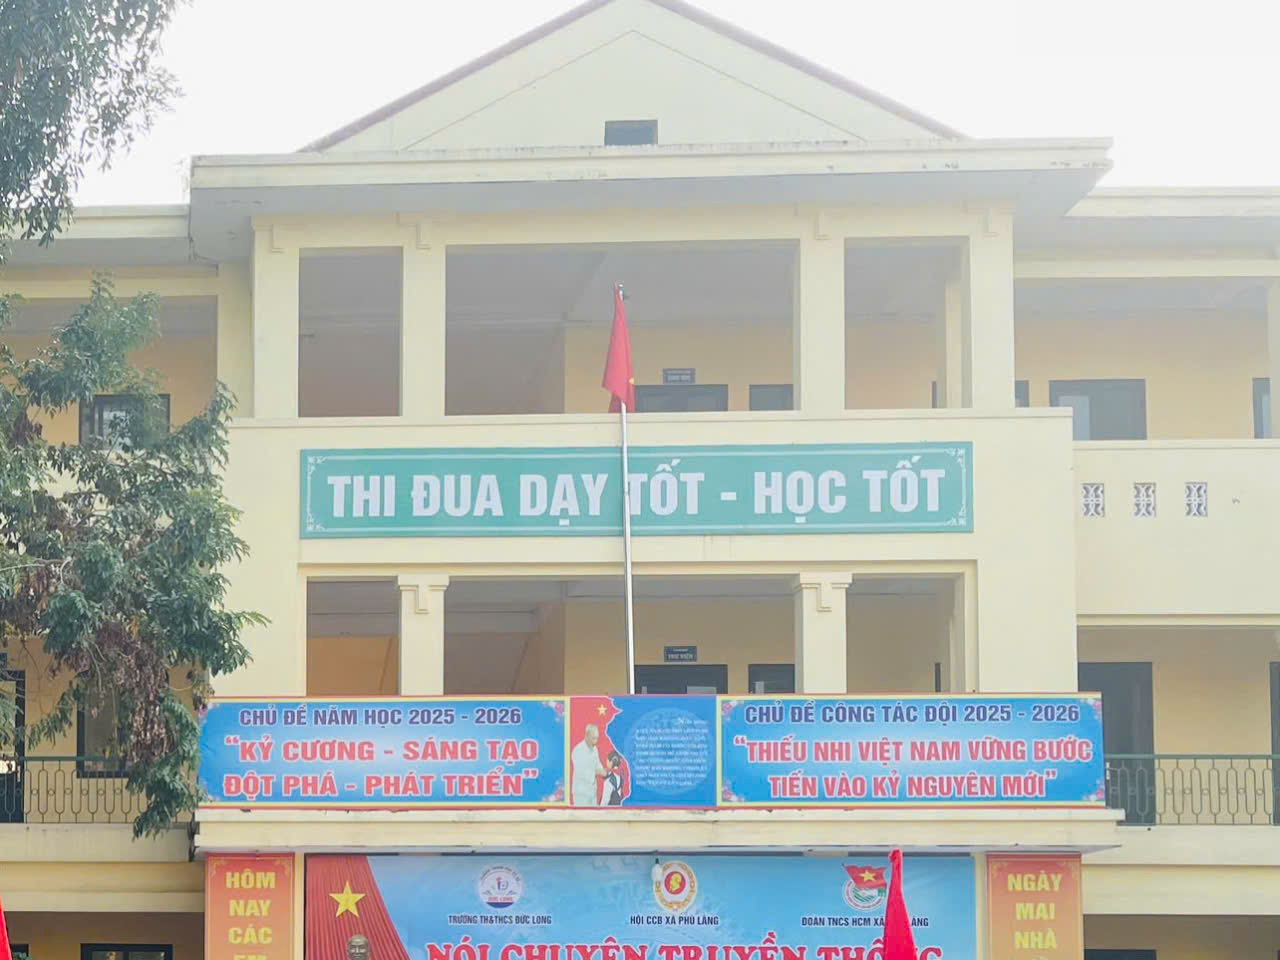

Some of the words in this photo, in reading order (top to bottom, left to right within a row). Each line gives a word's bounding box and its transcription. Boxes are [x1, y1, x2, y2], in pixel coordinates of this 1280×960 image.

[328, 474, 396, 517] THI
[411, 474, 504, 518] ĐUA
[520, 474, 608, 526] DẠY
[624, 457, 704, 516] TỐT
[753, 471, 846, 524] HỌC
[862, 455, 947, 513] TỐT
[239, 705, 277, 726] CHỦ
[283, 703, 307, 726] ĐỀ
[313, 705, 358, 726] NĂM
[364, 708, 402, 729] HỌC
[408, 708, 455, 725] 2025
[474, 708, 521, 725] 2026
[744, 702, 783, 724] CHỦ
[790, 701, 815, 724] ĐỀ
[821, 702, 874, 723] CÔNG
[881, 702, 918, 723] TÁC
[924, 702, 958, 728] ĐỘI
[964, 705, 1011, 723] 2025
[1031, 705, 1079, 722] 2026
[282, 738, 375, 761] CƯƠNG
[402, 736, 477, 761] SÁNG
[487, 739, 538, 764] TẠO
[814, 740, 851, 762] NHI
[857, 737, 903, 767] VIỆT
[910, 740, 963, 761] NAM
[968, 736, 1026, 762] VỮNG
[1033, 737, 1093, 762] BƯỚC
[223, 769, 276, 798] ĐỘT
[283, 769, 336, 797] PHÁ
[364, 769, 436, 796] PHÁT
[768, 769, 816, 798] TIẾN
[824, 770, 865, 798] VÀO
[872, 768, 899, 797] KỶ
[907, 770, 993, 797] NGUYÊN
[225, 869, 276, 889] HÔM
[1007, 869, 1062, 891] NGÀY
[229, 899, 271, 917] NAY
[1015, 903, 1056, 920] MAI
[532, 915, 552, 925] LONG
[646, 915, 663, 925] CCB
[828, 917, 849, 927] TNCS
[852, 917, 871, 927] HCM
[228, 923, 272, 945] CÁC
[1014, 928, 1057, 950] NHÀ
